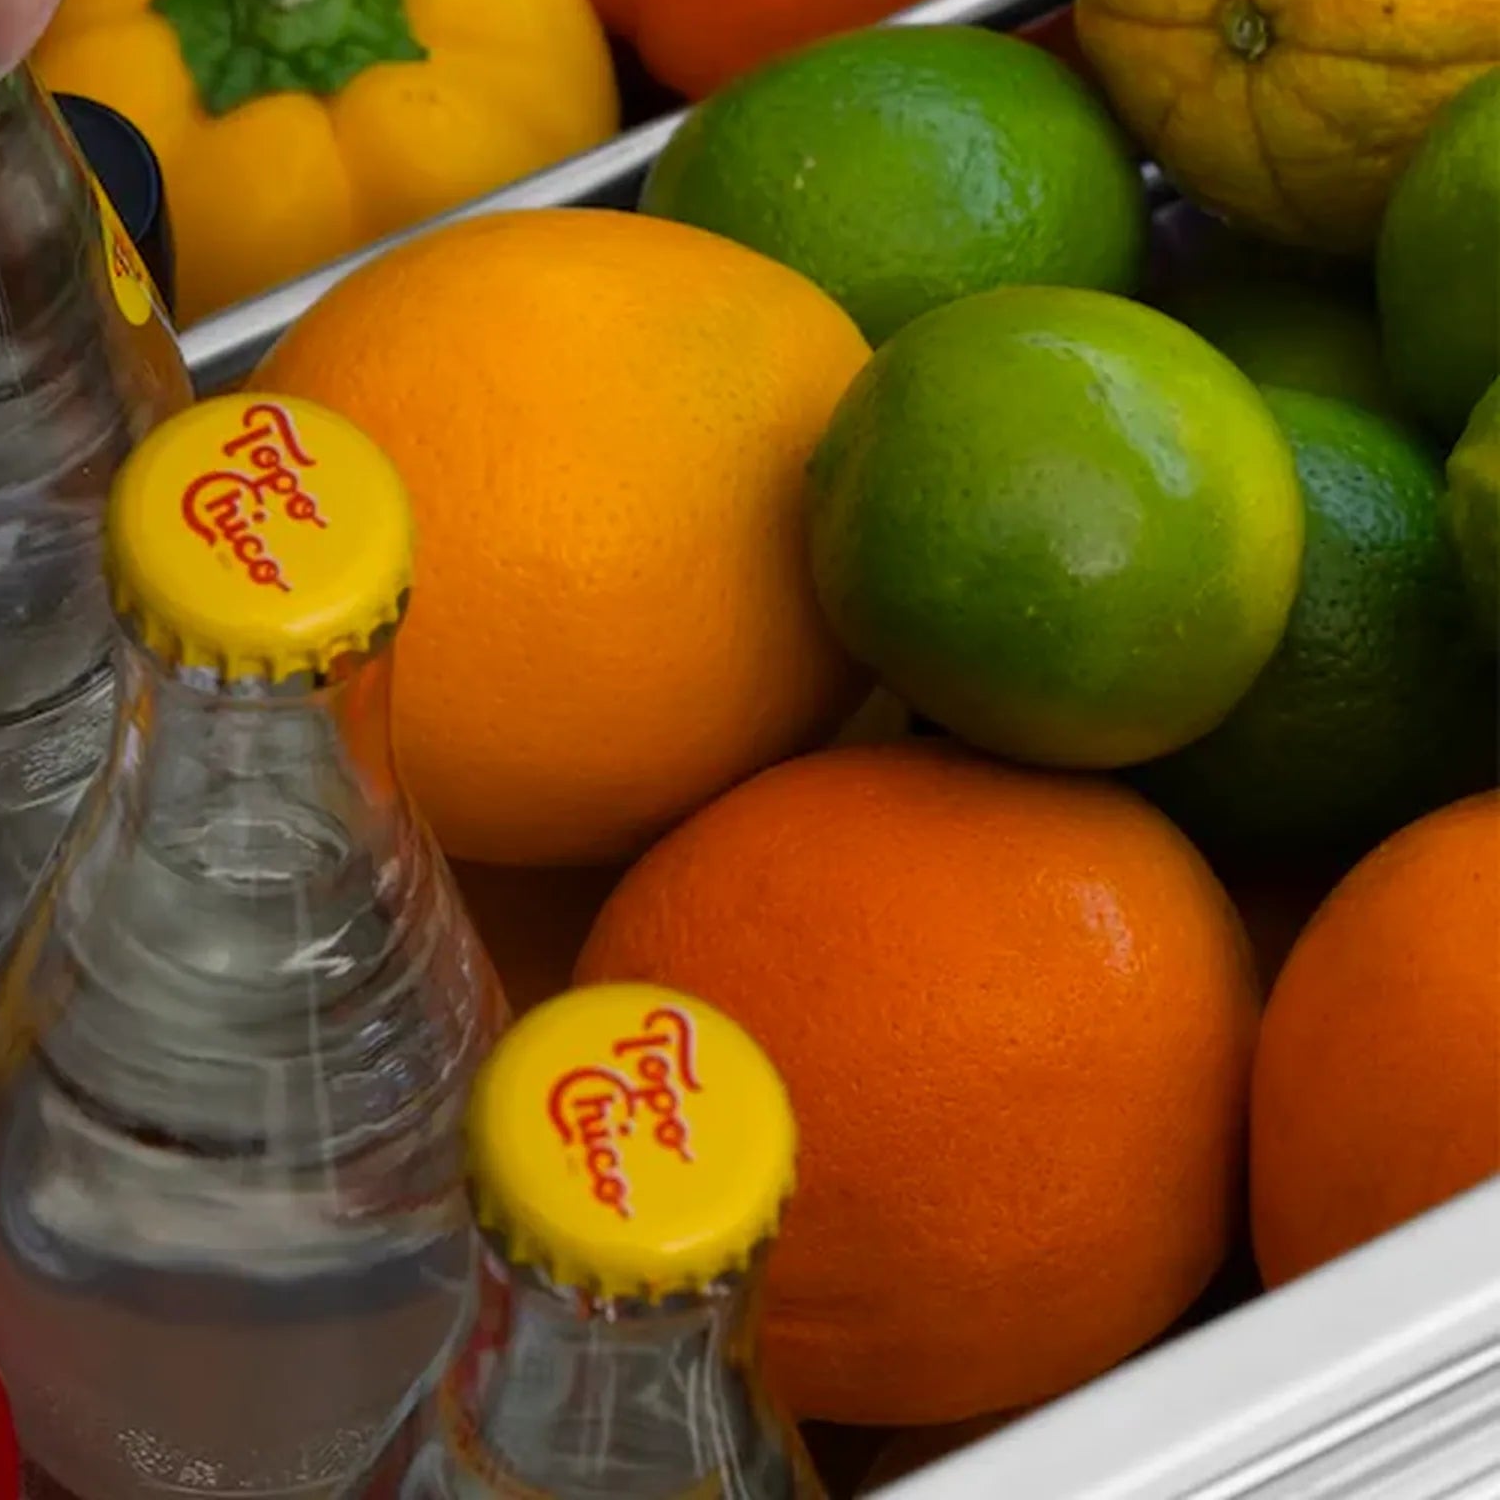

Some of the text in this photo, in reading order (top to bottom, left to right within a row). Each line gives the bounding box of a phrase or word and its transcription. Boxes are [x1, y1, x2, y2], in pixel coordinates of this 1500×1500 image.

[181, 471, 293, 593] Chico
[223, 403, 329, 530] Topo
[548, 1067, 631, 1220] Chico
[613, 1008, 703, 1163] Topo
